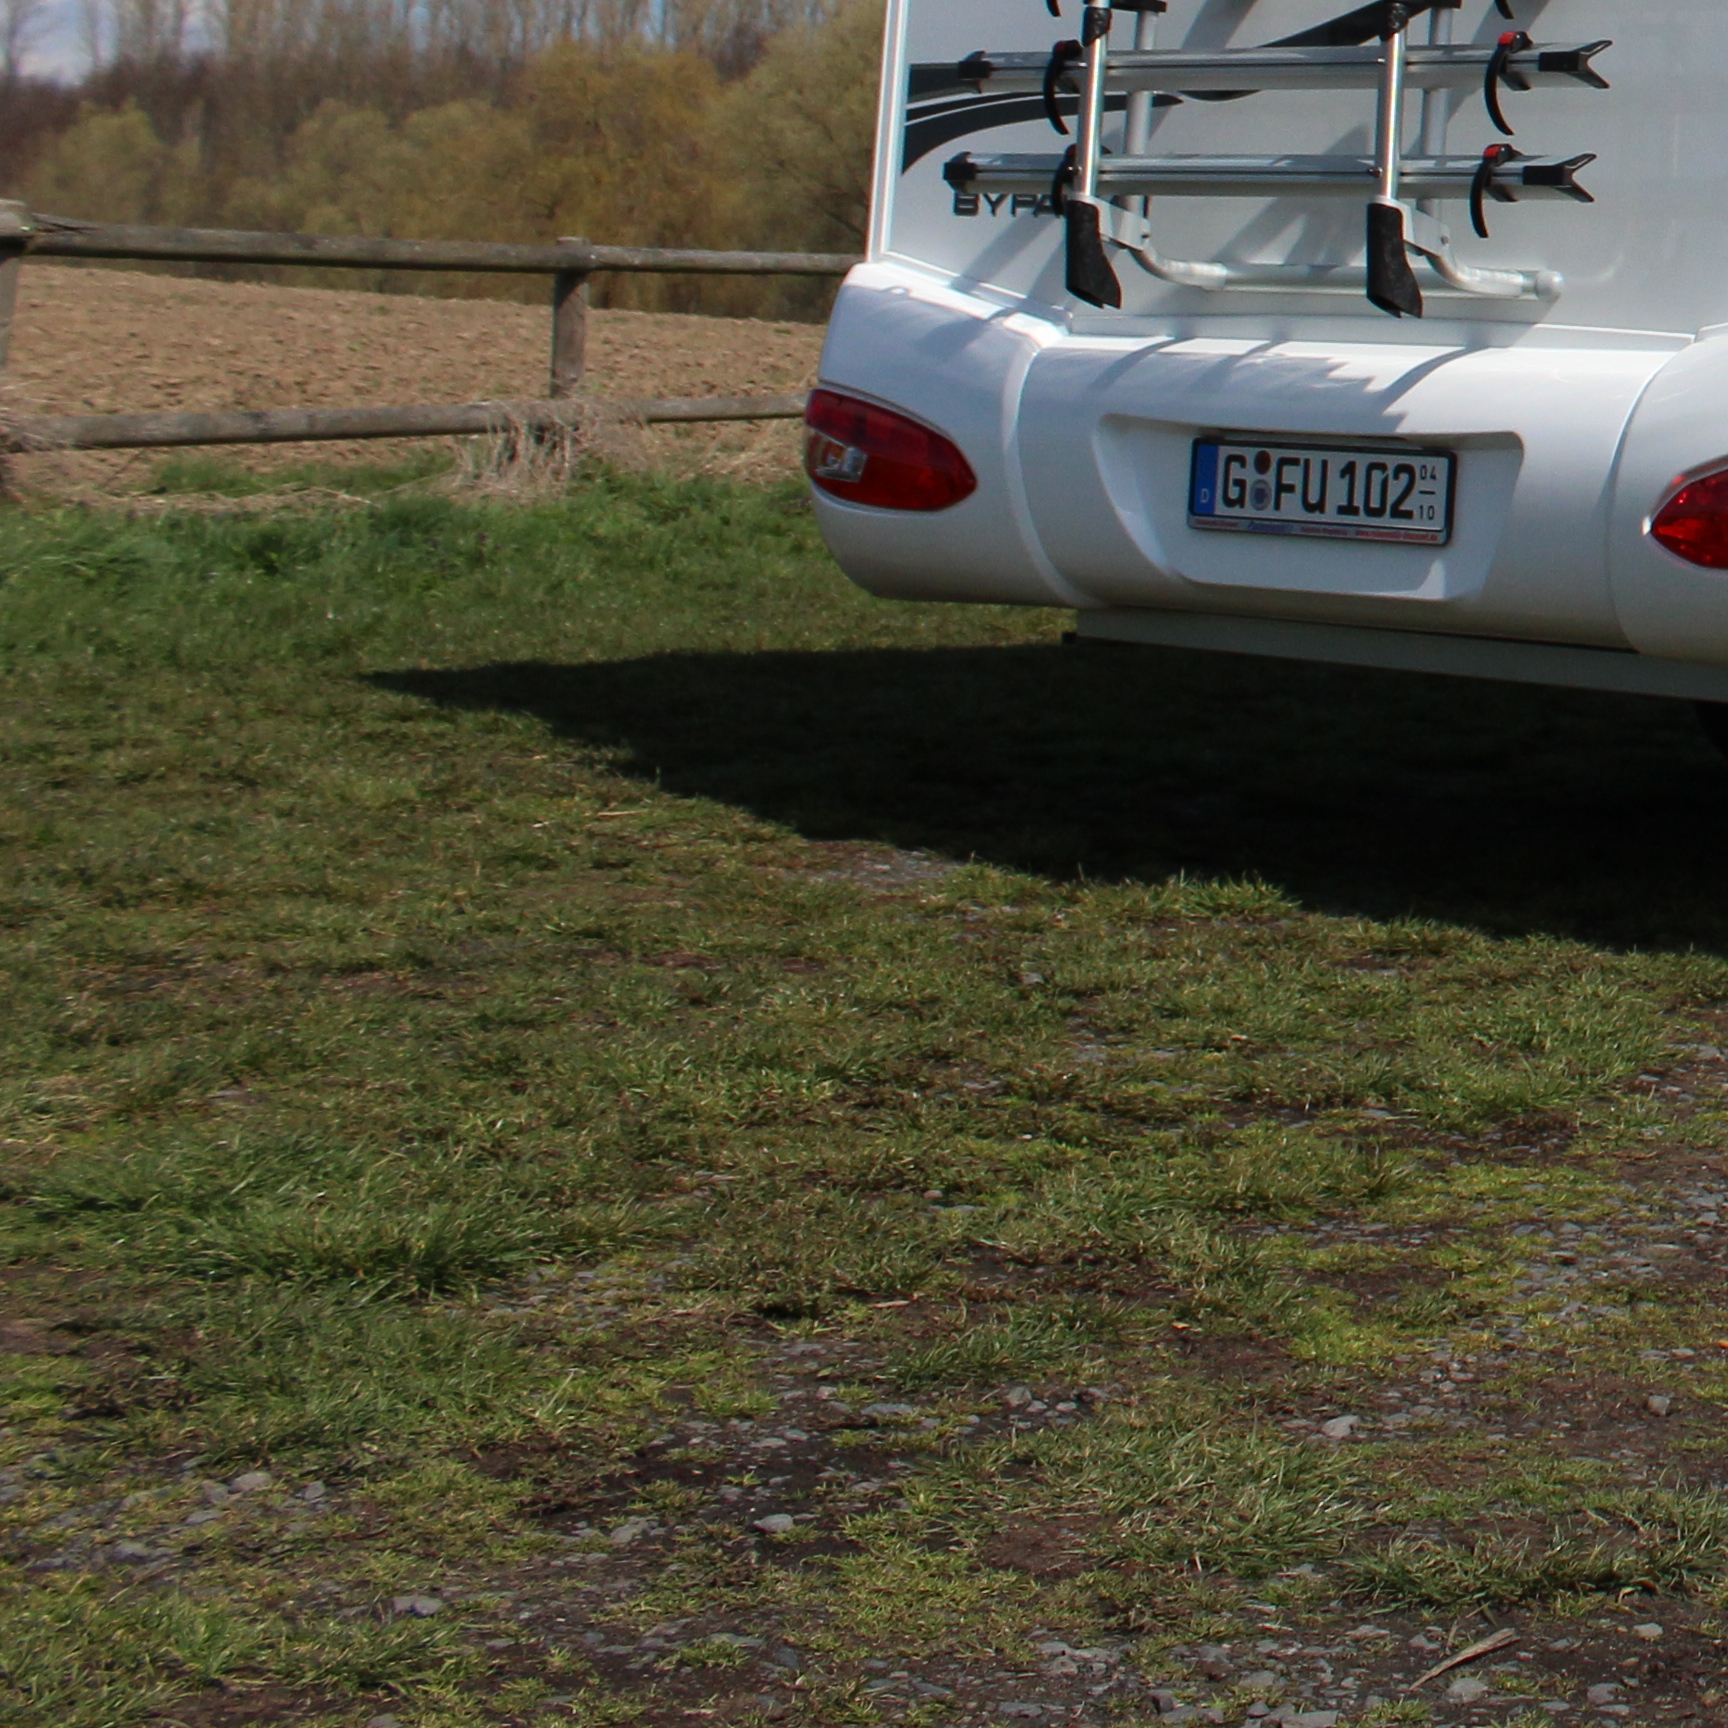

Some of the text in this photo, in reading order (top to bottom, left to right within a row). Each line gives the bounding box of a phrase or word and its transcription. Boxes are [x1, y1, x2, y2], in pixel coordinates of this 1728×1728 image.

[1419, 464, 1437, 481] 04
[1222, 453, 1417, 520] G FU 102
[1200, 488, 1210, 503] D
[1419, 504, 1435, 521] 10
